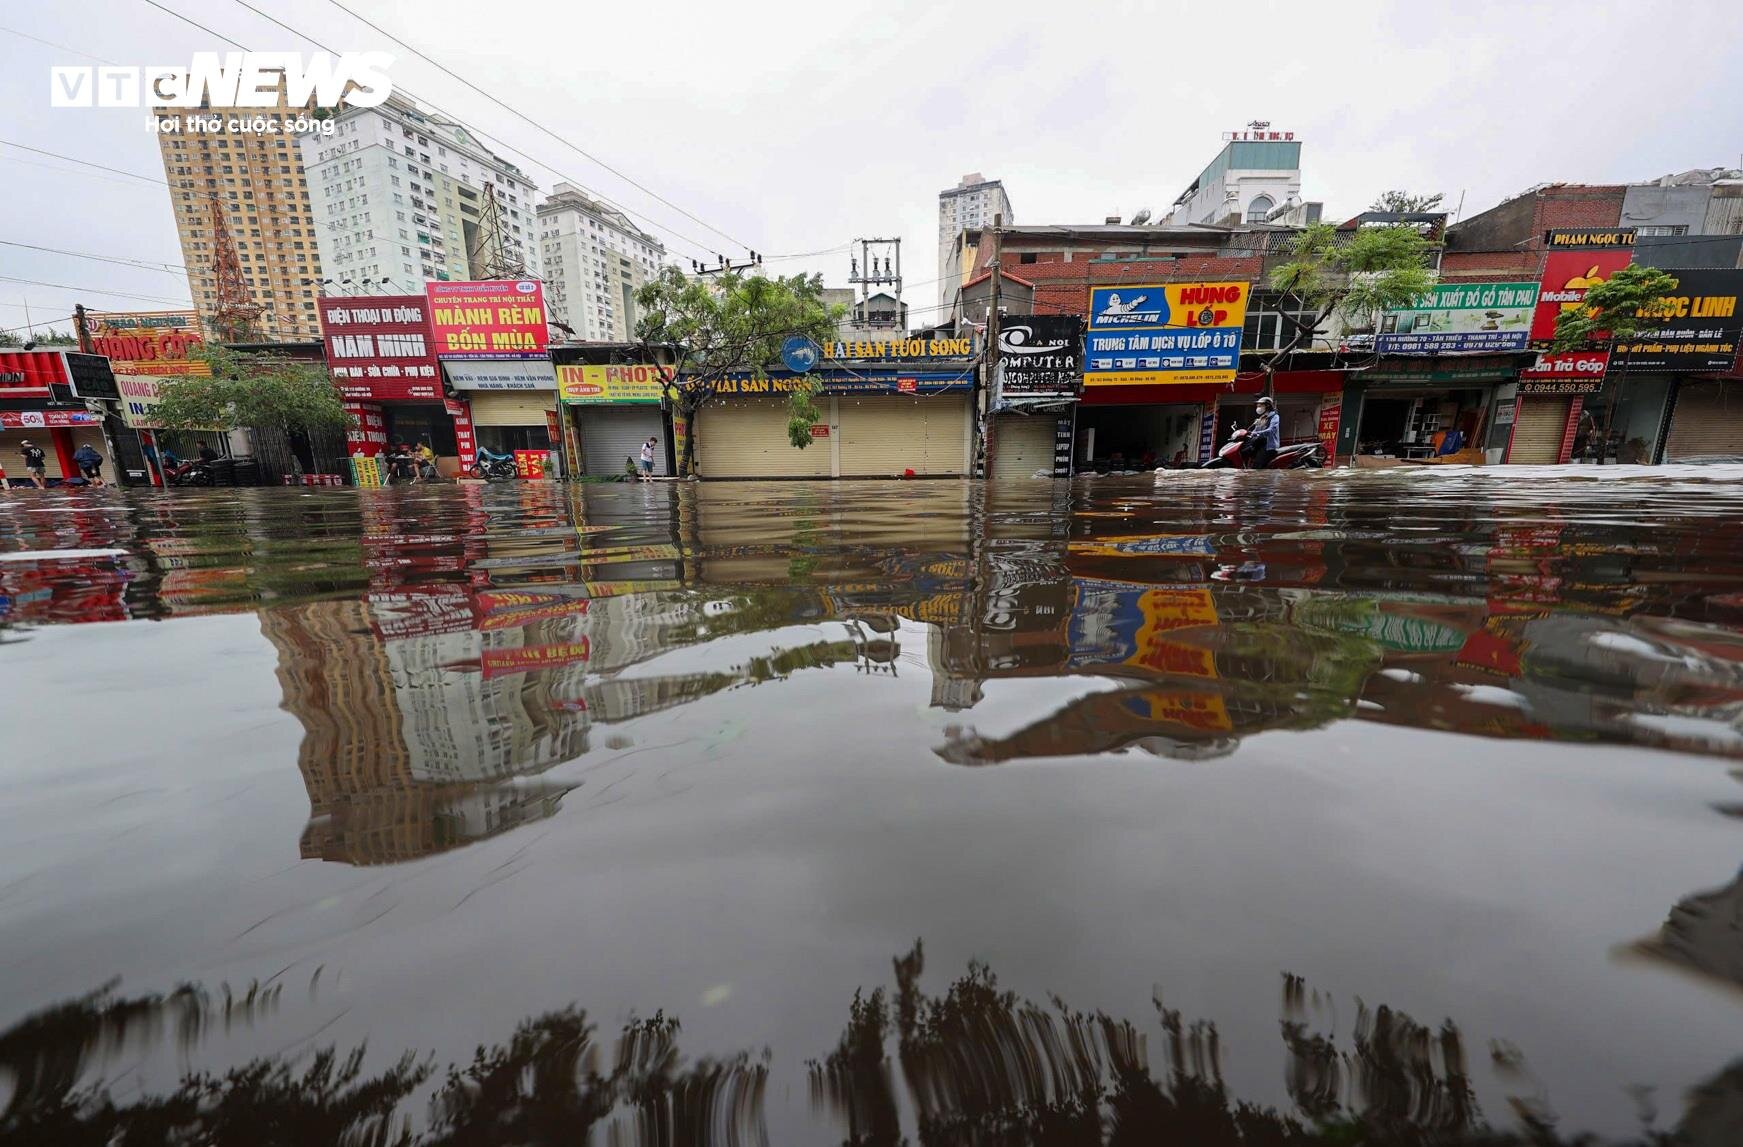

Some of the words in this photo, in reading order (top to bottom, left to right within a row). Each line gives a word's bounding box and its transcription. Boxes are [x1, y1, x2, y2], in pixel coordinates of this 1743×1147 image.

[1554, 234, 1587, 247] PHẠM
[1589, 233, 1619, 247] NGỌC
[1180, 284, 1241, 304] HÙNG
[1439, 286, 1465, 307] XUẤT
[1515, 287, 1534, 305] PHÚ
[1541, 291, 1581, 301] Mobile
[327, 307, 351, 325] ĐIỆN
[351, 309, 380, 325] THOẠI
[381, 309, 392, 322] DI
[393, 306, 422, 324] ĐỘNG
[434, 305, 493, 325] MÀNH
[498, 304, 542, 325] RÈM
[1690, 297, 1736, 317] LINH
[1096, 314, 1161, 324] MICHELIN
[331, 335, 375, 357] NAM
[377, 334, 426, 357] MINH
[446, 327, 487, 350] BỐN
[491, 329, 537, 350] MÙA
[890, 338, 926, 357] TƯƠI
[1092, 337, 1126, 351] TRUNG
[1128, 335, 1148, 350] TÂM
[1152, 336, 1175, 352] DỊCH
[1177, 335, 1190, 351] VỤ
[1191, 331, 1211, 349] LỐP
[1213, 332, 1220, 347] Ô
[1223, 332, 1236, 348] TÔ
[562, 367, 584, 383] IN
[1554, 358, 1574, 372] Trả
[1576, 358, 1604, 373] Góp
[741, 374, 769, 392] SẢN
[1534, 383, 1557, 391] 0944
[1559, 383, 1576, 391] 550
[1578, 383, 1595, 391] 595
[1323, 421, 1334, 429] XE
